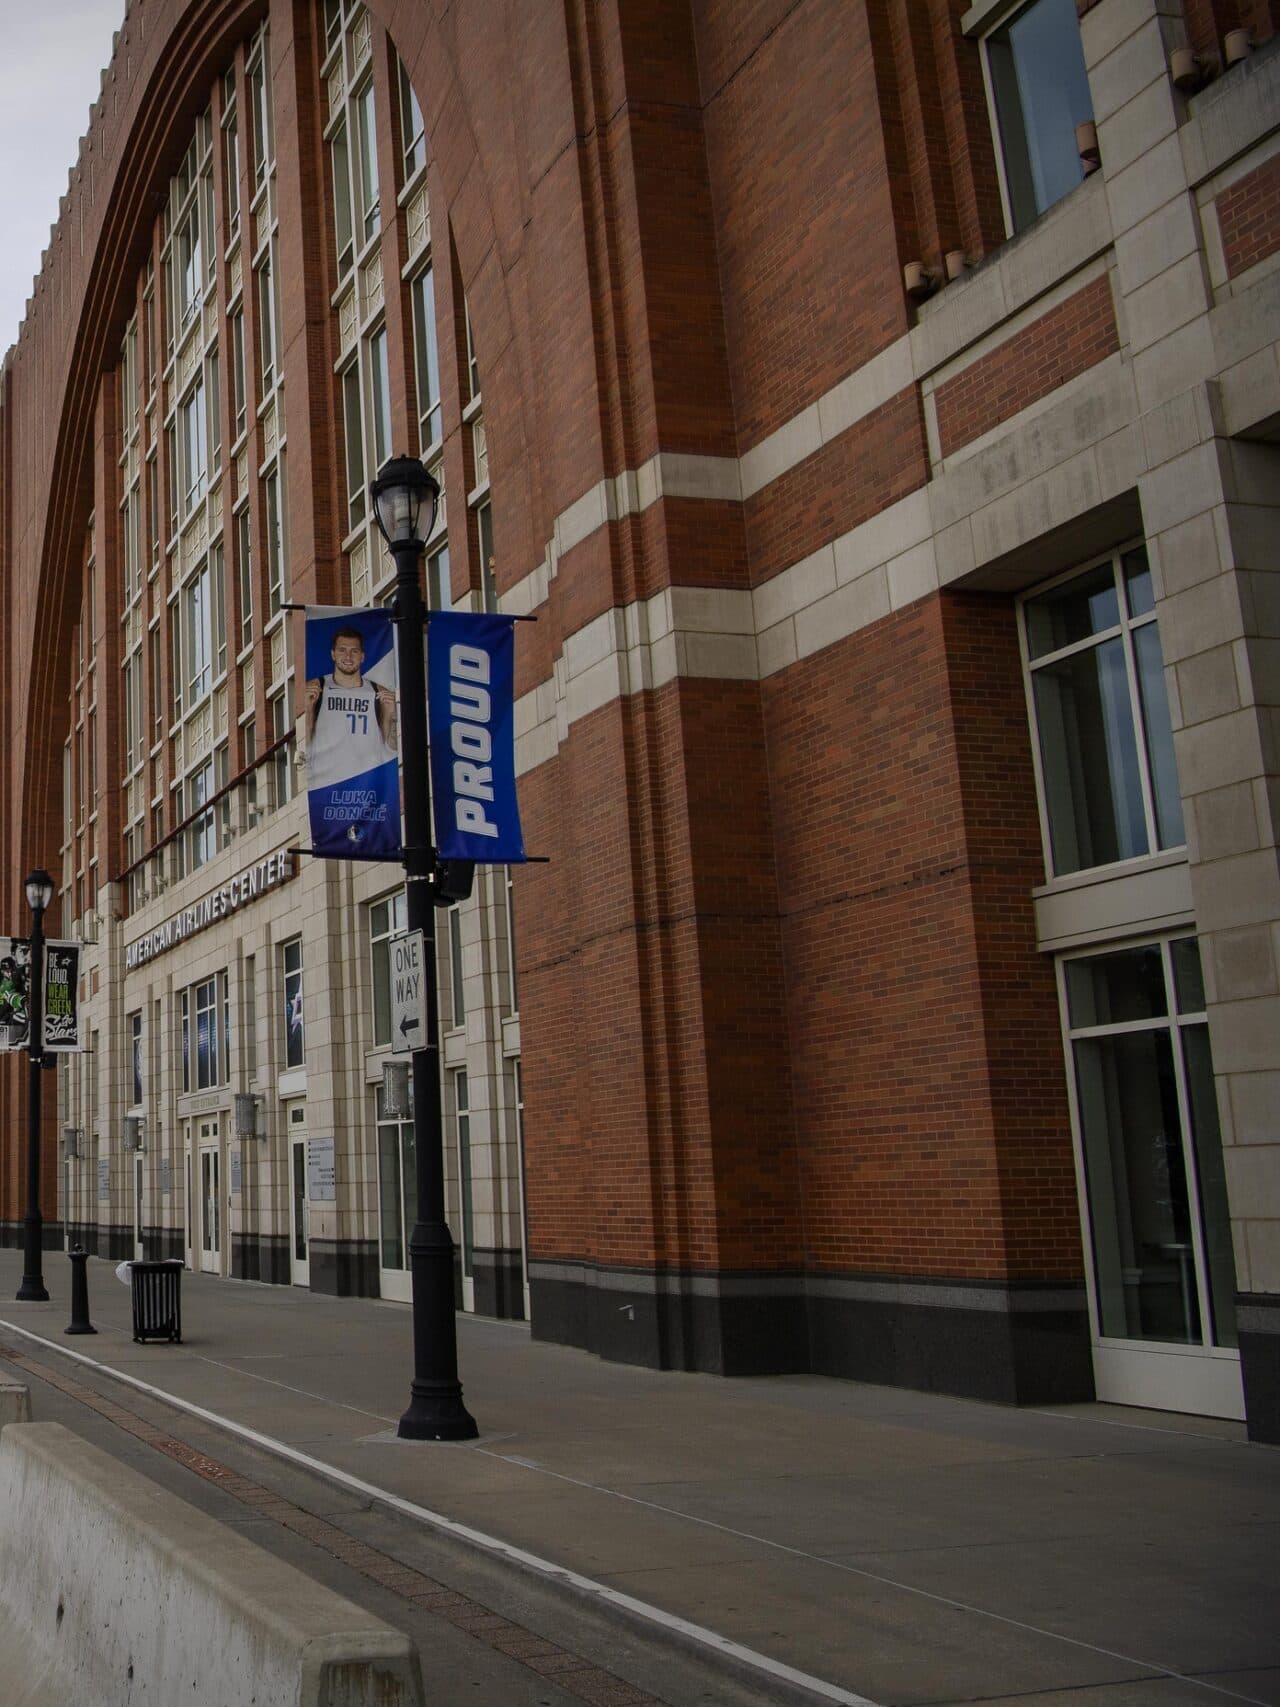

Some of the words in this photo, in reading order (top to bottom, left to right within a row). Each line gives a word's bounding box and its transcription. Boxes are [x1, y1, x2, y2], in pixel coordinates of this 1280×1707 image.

[327, 696, 370, 712] DALLAS
[346, 713, 368, 735] 77
[450, 644, 499, 838] PROUD
[331, 790, 377, 804] LUKA
[324, 803, 387, 822] DONČIĆ
[126, 922, 172, 969] AMERICAN
[175, 888, 227, 940] AIRLINES
[230, 851, 287, 907] CENTER
[48, 952, 59, 968] BE
[396, 943, 418, 972] ONE
[48, 968, 69, 984] LOUD.
[47, 984, 69, 999] WEAR
[396, 973, 419, 1004] WAY
